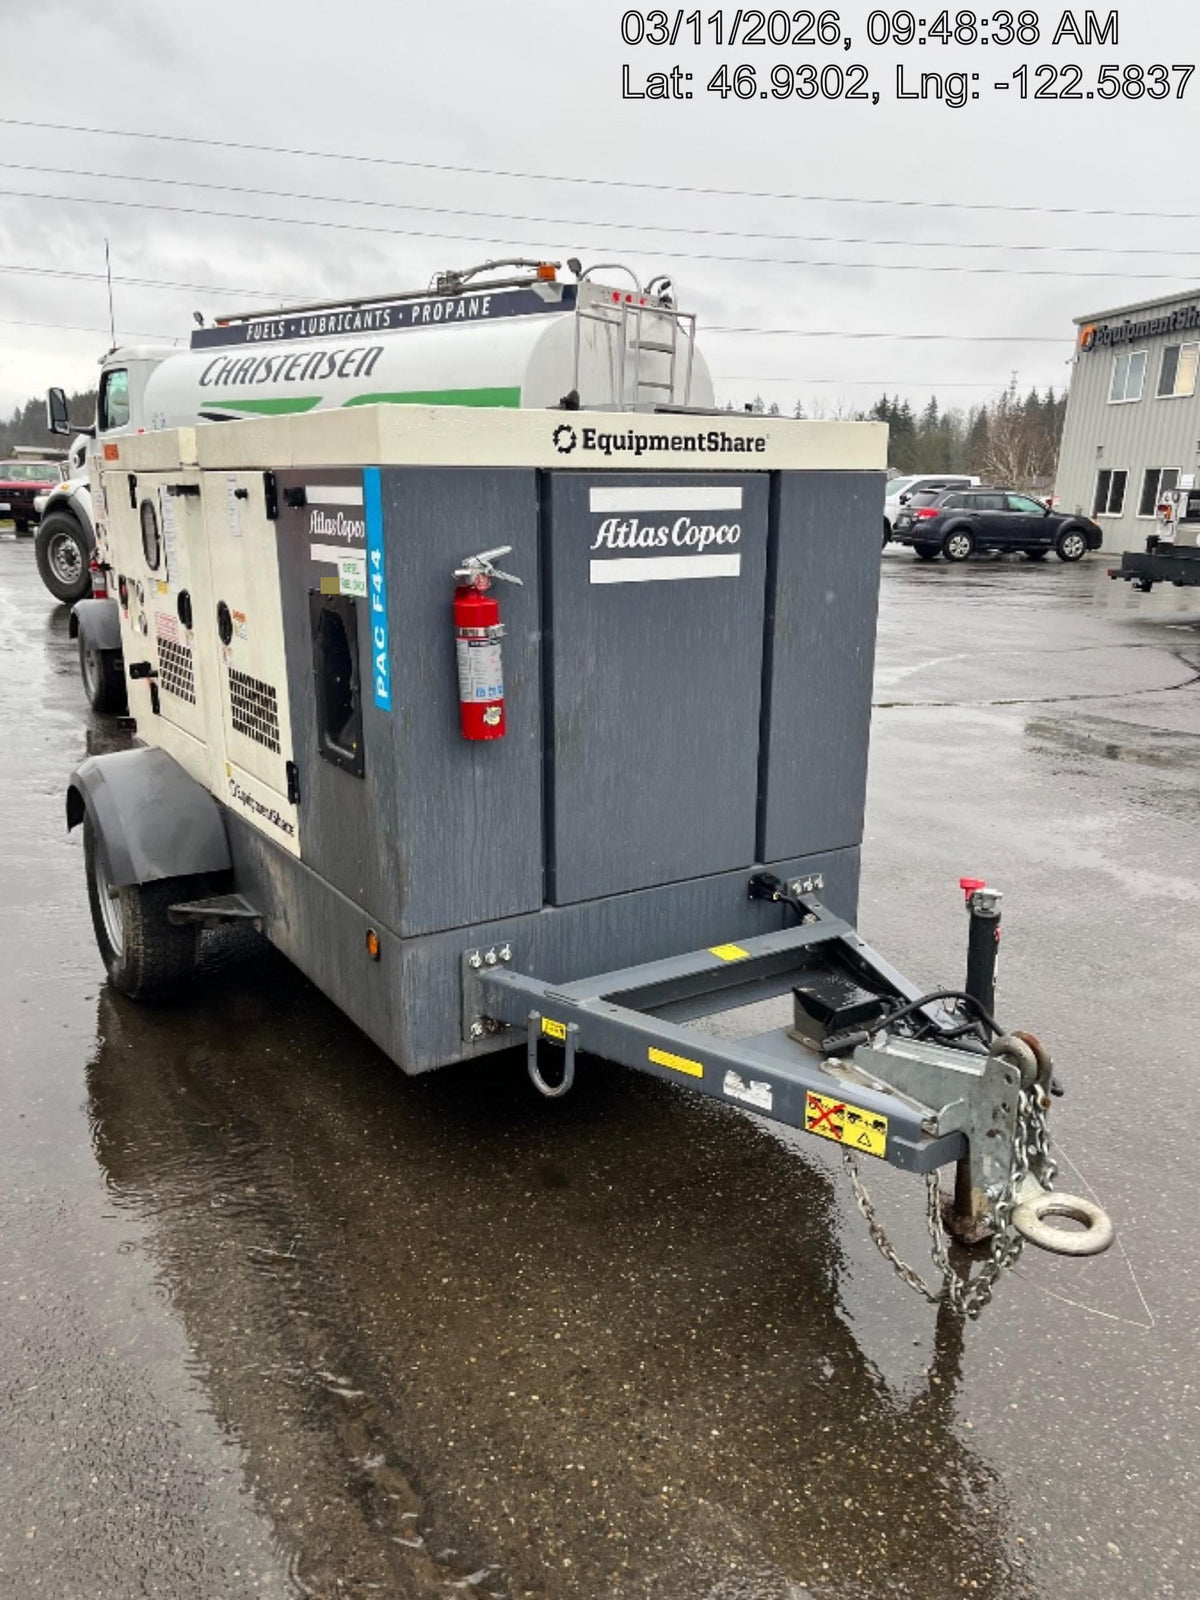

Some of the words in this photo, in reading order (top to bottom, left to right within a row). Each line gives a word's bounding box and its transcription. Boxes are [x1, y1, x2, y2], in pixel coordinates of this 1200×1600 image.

[246, 320, 286, 341] FUELS
[300, 308, 392, 336] LUBRICANTS
[411, 296, 492, 323] PROPANE
[582, 428, 766, 456] EquipmentShare
[371, 548, 384, 613] F44
[374, 625, 389, 699] PAC
